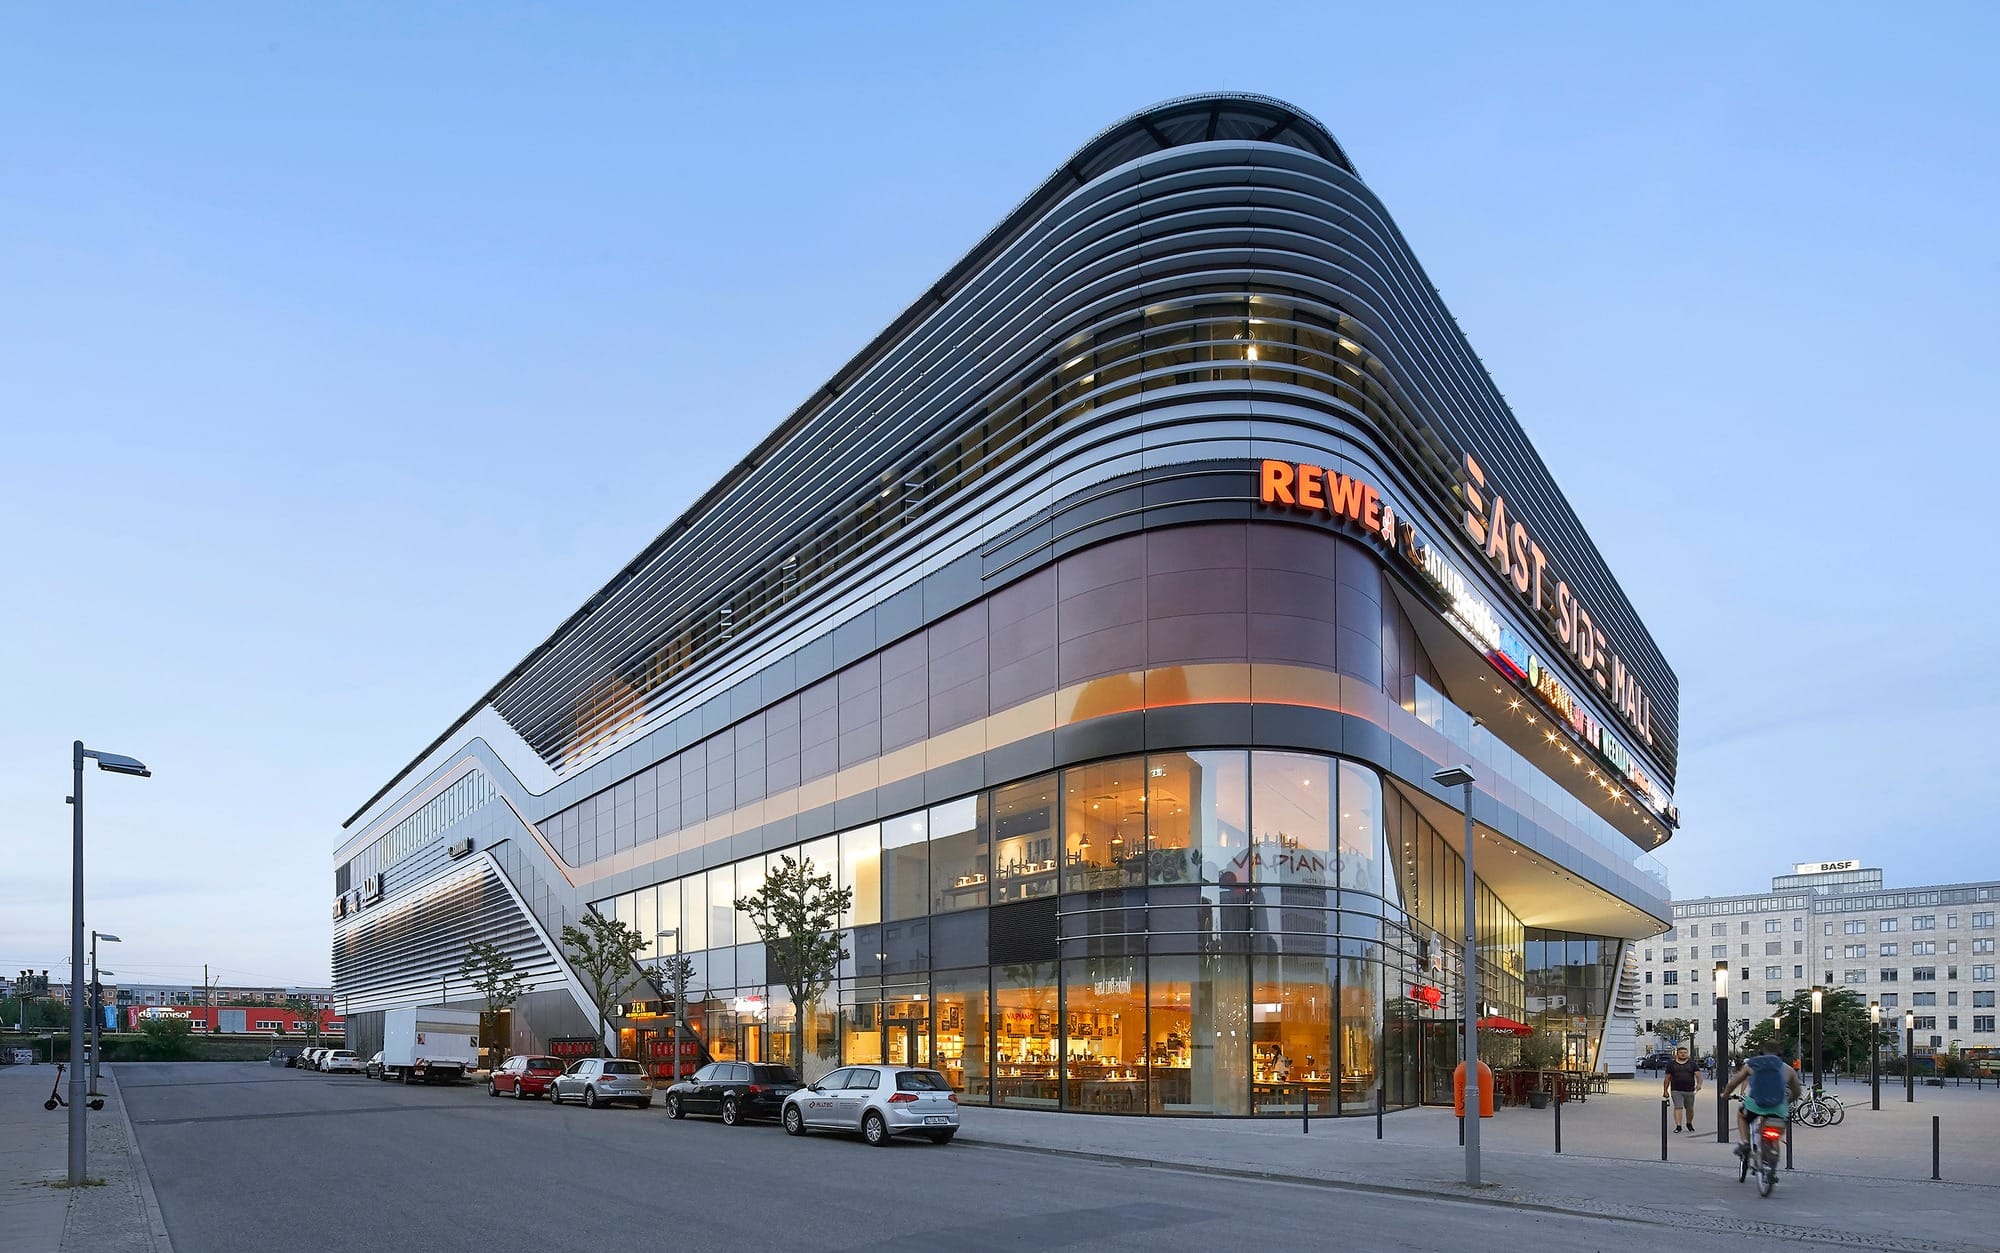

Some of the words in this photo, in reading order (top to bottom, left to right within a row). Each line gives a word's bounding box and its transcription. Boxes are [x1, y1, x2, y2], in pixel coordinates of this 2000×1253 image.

[1261, 459, 1380, 532] REWE
[1462, 452, 1546, 611] EAST
[1554, 580, 1606, 690] SIDE
[1611, 654, 1653, 746] MALL
[1820, 861, 1852, 871] BASF
[631, 1002, 646, 1012] ZEN
